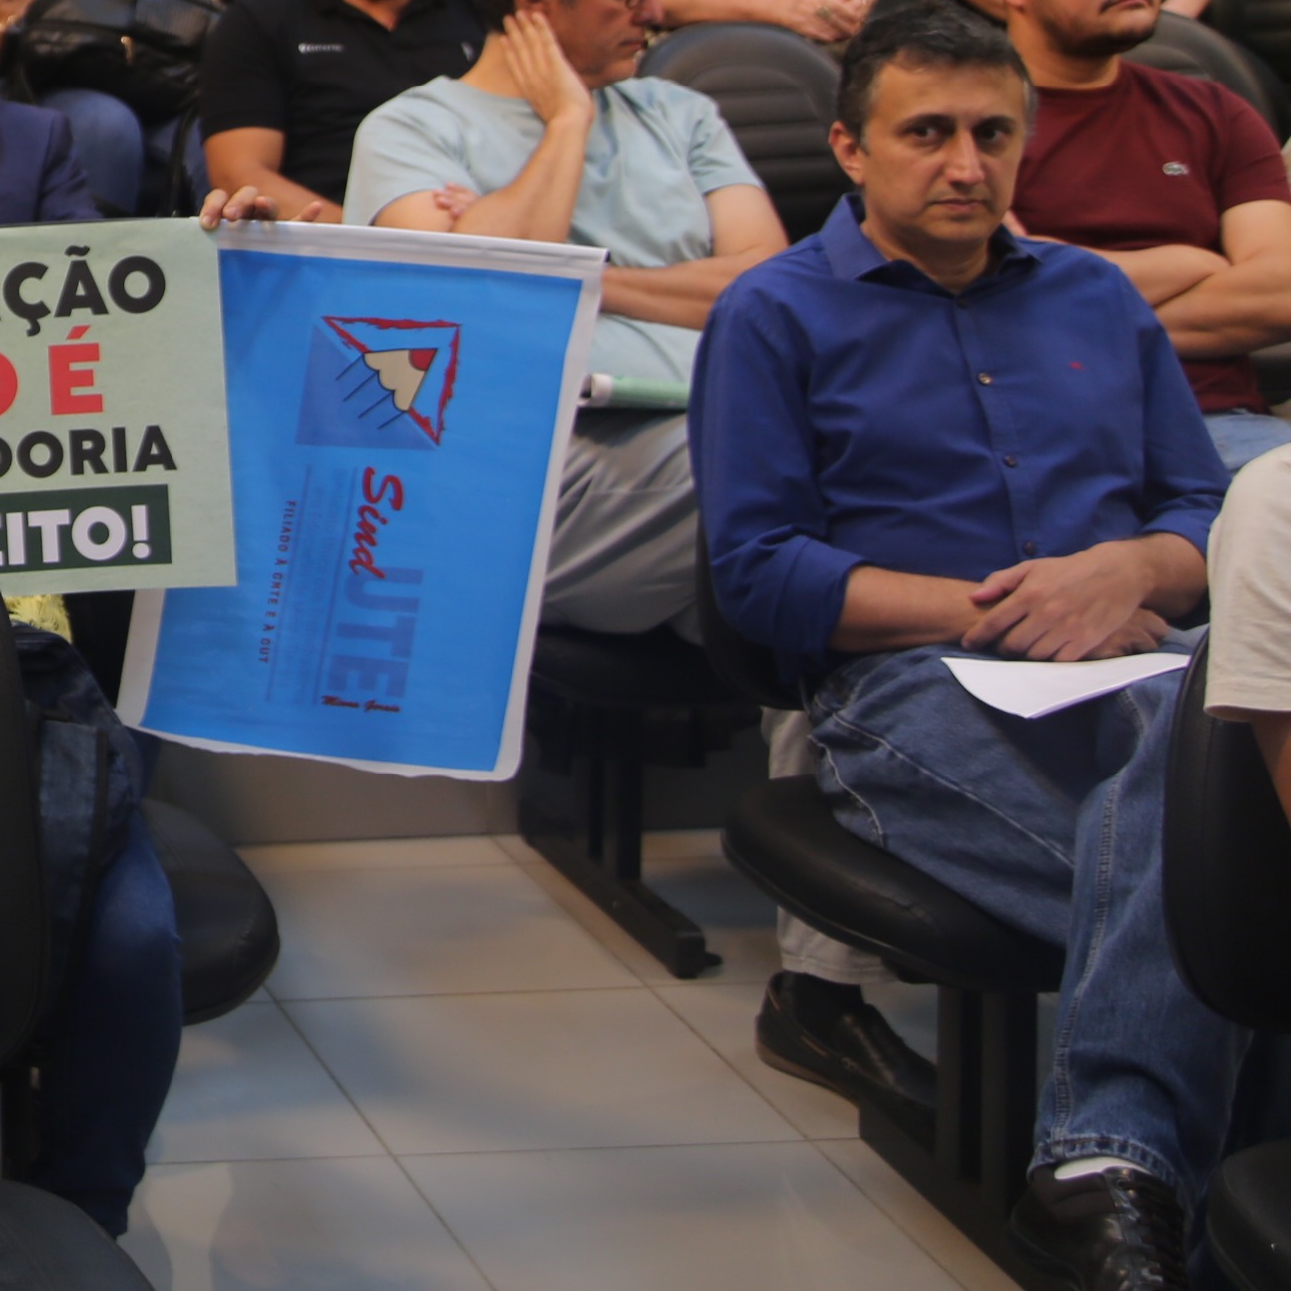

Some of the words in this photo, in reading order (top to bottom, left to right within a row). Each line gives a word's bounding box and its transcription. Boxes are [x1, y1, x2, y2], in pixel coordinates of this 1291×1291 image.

[48, 325, 104, 416] É
[278, 500, 297, 552] FILIADO
[349, 466, 403, 579] Sind
[326, 565, 424, 698] UTE
